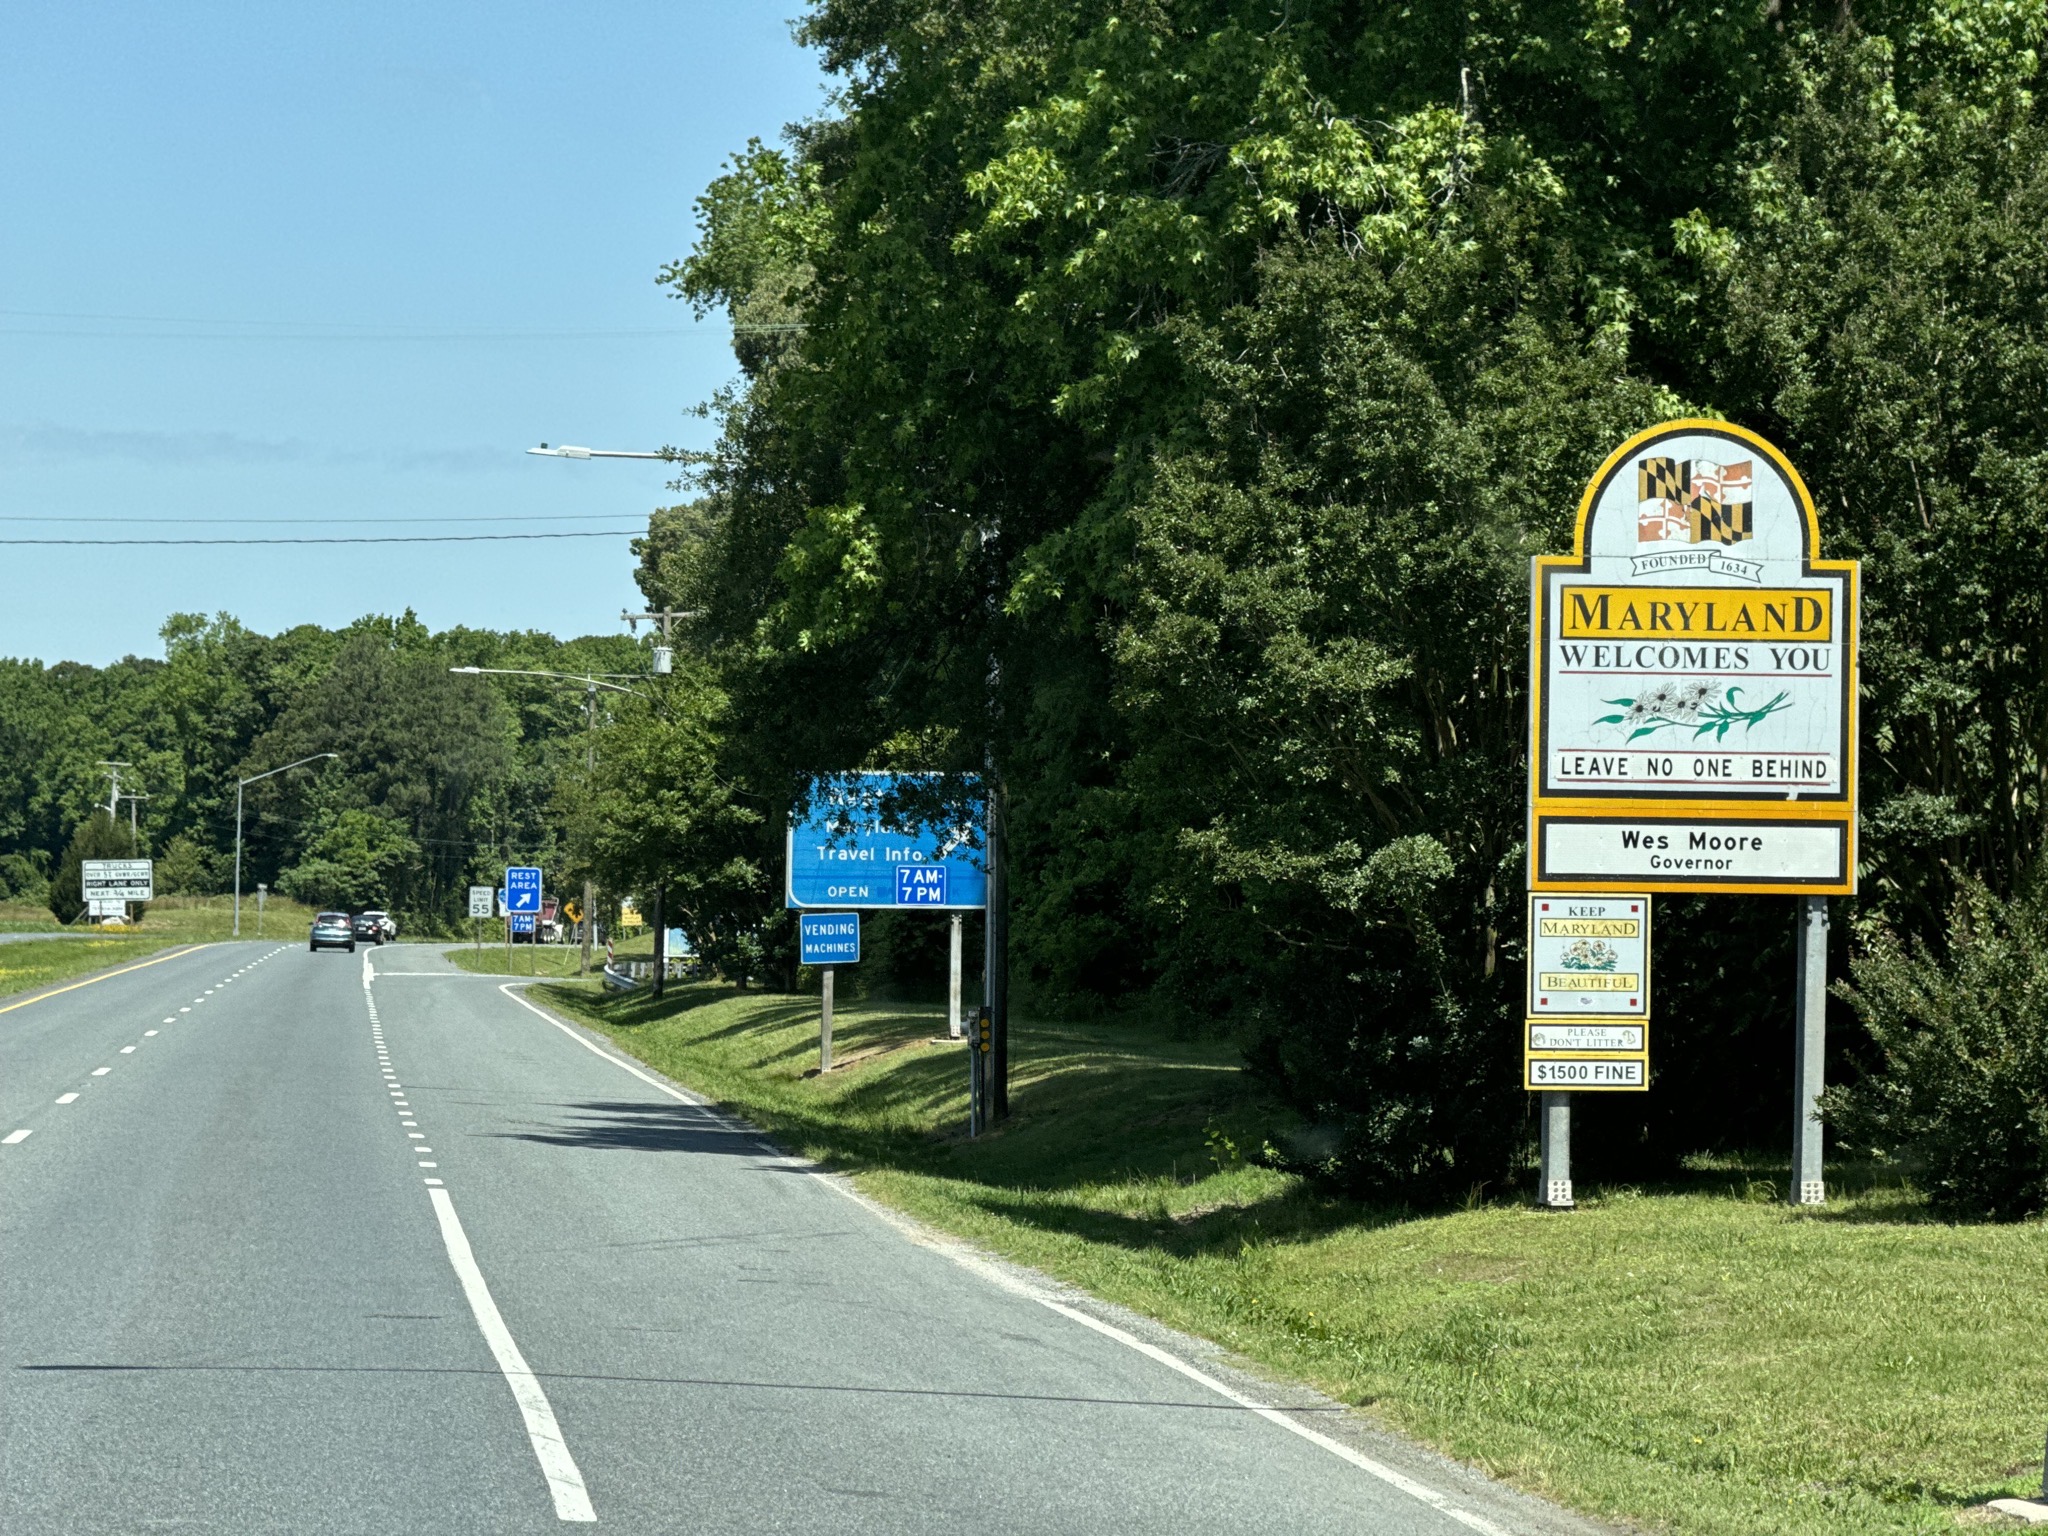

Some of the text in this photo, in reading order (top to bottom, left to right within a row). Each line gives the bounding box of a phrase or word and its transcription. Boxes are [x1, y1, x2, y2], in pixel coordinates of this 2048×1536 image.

[1640, 554, 1748, 577] FOUNDED 1634
[1569, 593, 1823, 633] MARYLAND
[1560, 645, 1831, 671] WELCOMES YOU
[1561, 756, 1827, 779] LEAVE NO ONE BEHIND
[1622, 831, 1763, 851] Wes Moore
[817, 846, 874, 861] Travel
[1650, 855, 1733, 870] Governor
[900, 869, 910, 883] 7
[828, 886, 869, 898] OPEN
[902, 887, 941, 901] 7 PM
[472, 904, 489, 914] 55
[1568, 906, 1606, 917] KEEP
[804, 923, 855, 936] VENDING
[1543, 922, 1636, 935] MARYLAND
[806, 943, 856, 954] MACHINES
[1547, 976, 1633, 989] BEAUTIFUL
[1567, 1028, 1607, 1037] PLEASE
[1550, 1038, 1624, 1047] DON'T LITTER
[1537, 1065, 1636, 1081] $1500 FINE
